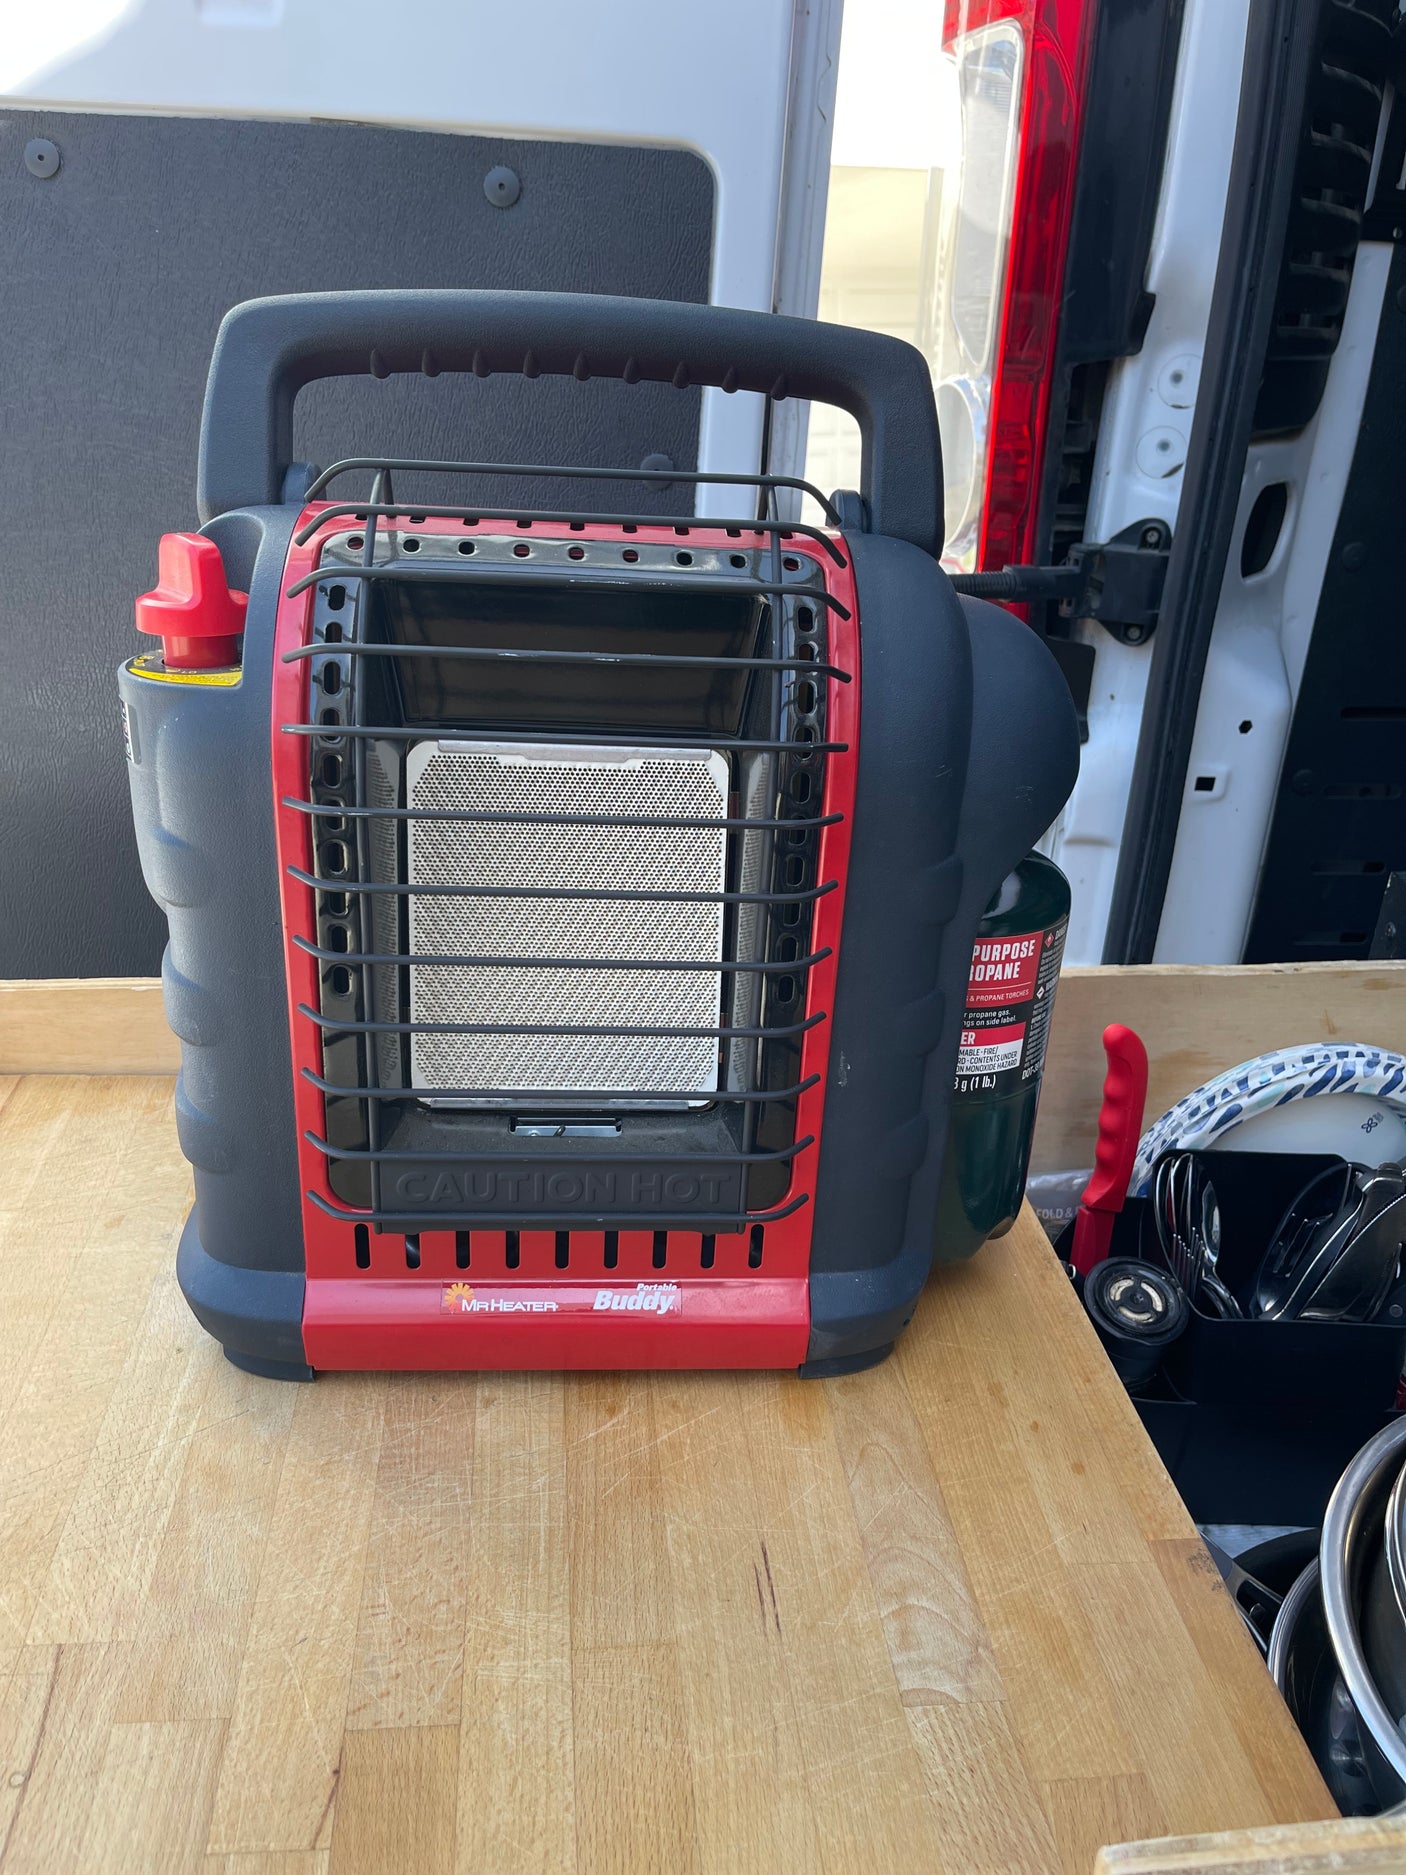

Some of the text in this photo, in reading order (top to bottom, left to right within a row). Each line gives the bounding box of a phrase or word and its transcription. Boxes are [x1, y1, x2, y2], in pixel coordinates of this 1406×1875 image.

[972, 940, 1036, 961] PURPOSE
[976, 993, 1005, 1002] PROPANE
[1006, 989, 1029, 999] TORCHES
[968, 1011, 997, 1019] propane
[965, 1063, 997, 1073] MONOXIDE
[997, 1058, 1018, 1069] HAZARD
[969, 1055, 1000, 1065] CONTENTS
[1001, 1051, 1017, 1061] UNDER
[961, 1080, 968, 1092] g
[982, 1074, 996, 1089] lb.)
[396, 1171, 732, 1204] CAUTION HOT
[637, 1283, 678, 1291] Portable
[593, 1290, 675, 1315] Buddy
